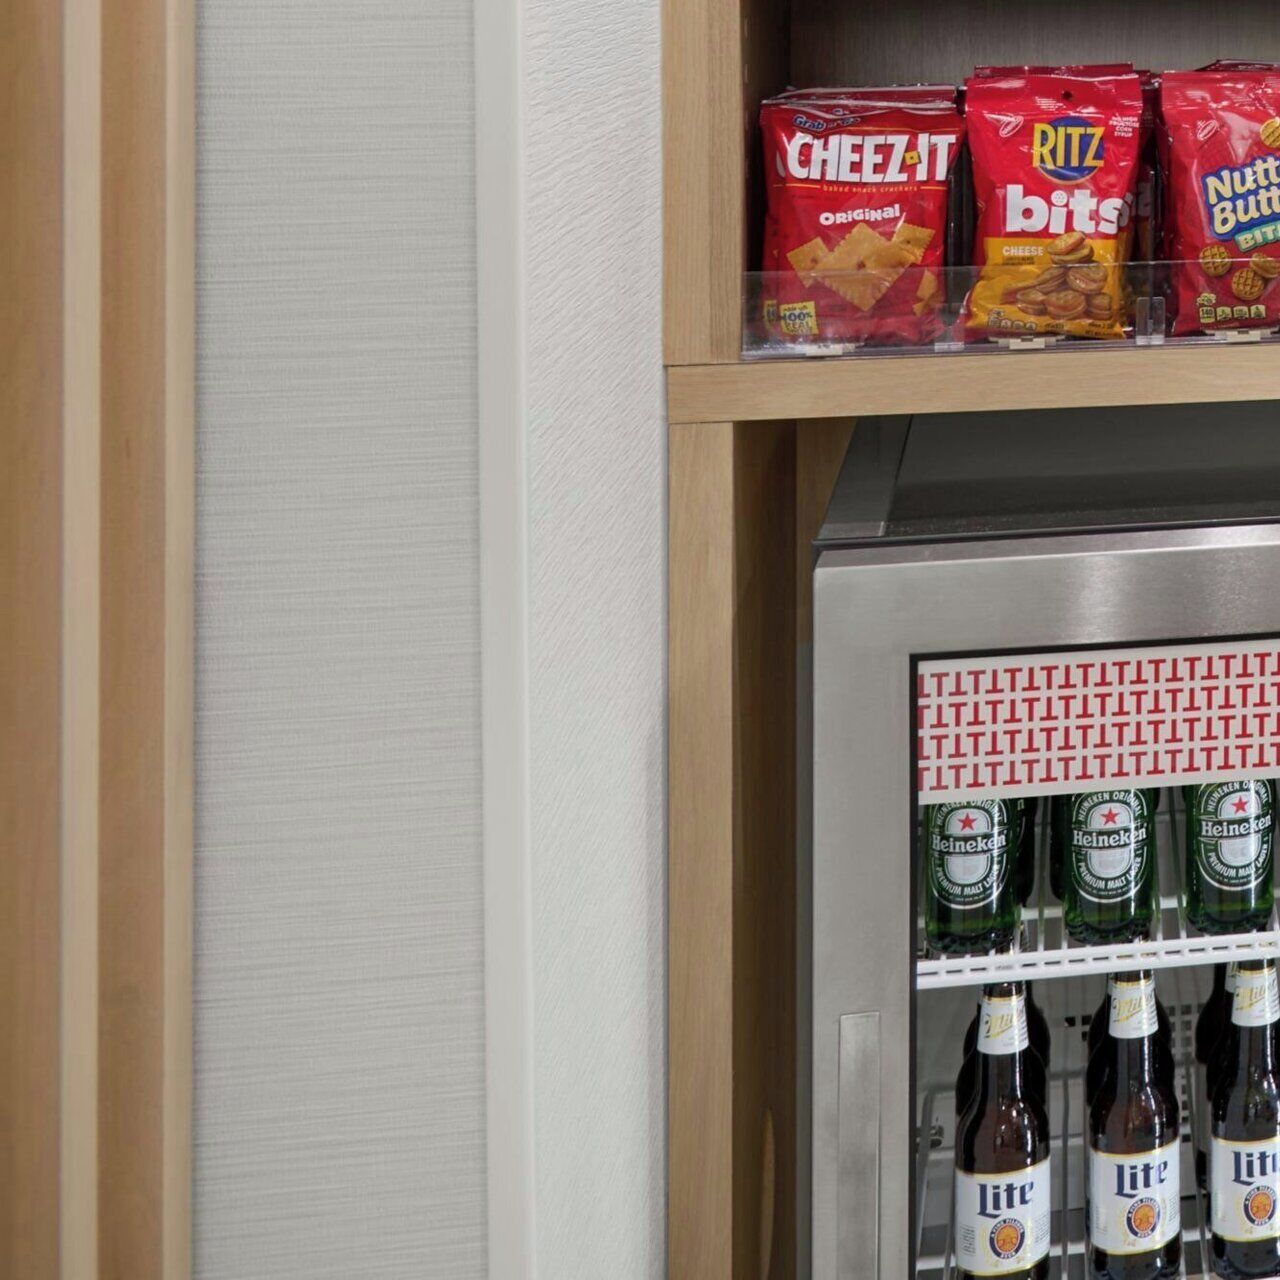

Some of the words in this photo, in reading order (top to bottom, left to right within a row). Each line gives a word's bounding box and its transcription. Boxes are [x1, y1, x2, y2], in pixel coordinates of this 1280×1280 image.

[1032, 123, 1105, 171] RITZ
[1006, 184, 1125, 235] bits
[1003, 246, 1043, 256] CHEESE
[1073, 826, 1147, 847] Heineken
[1201, 815, 1271, 838] Heineken
[933, 834, 1006, 854] Heineken
[1115, 1160, 1168, 1199] Lite
[977, 1180, 1034, 1219] Lite
